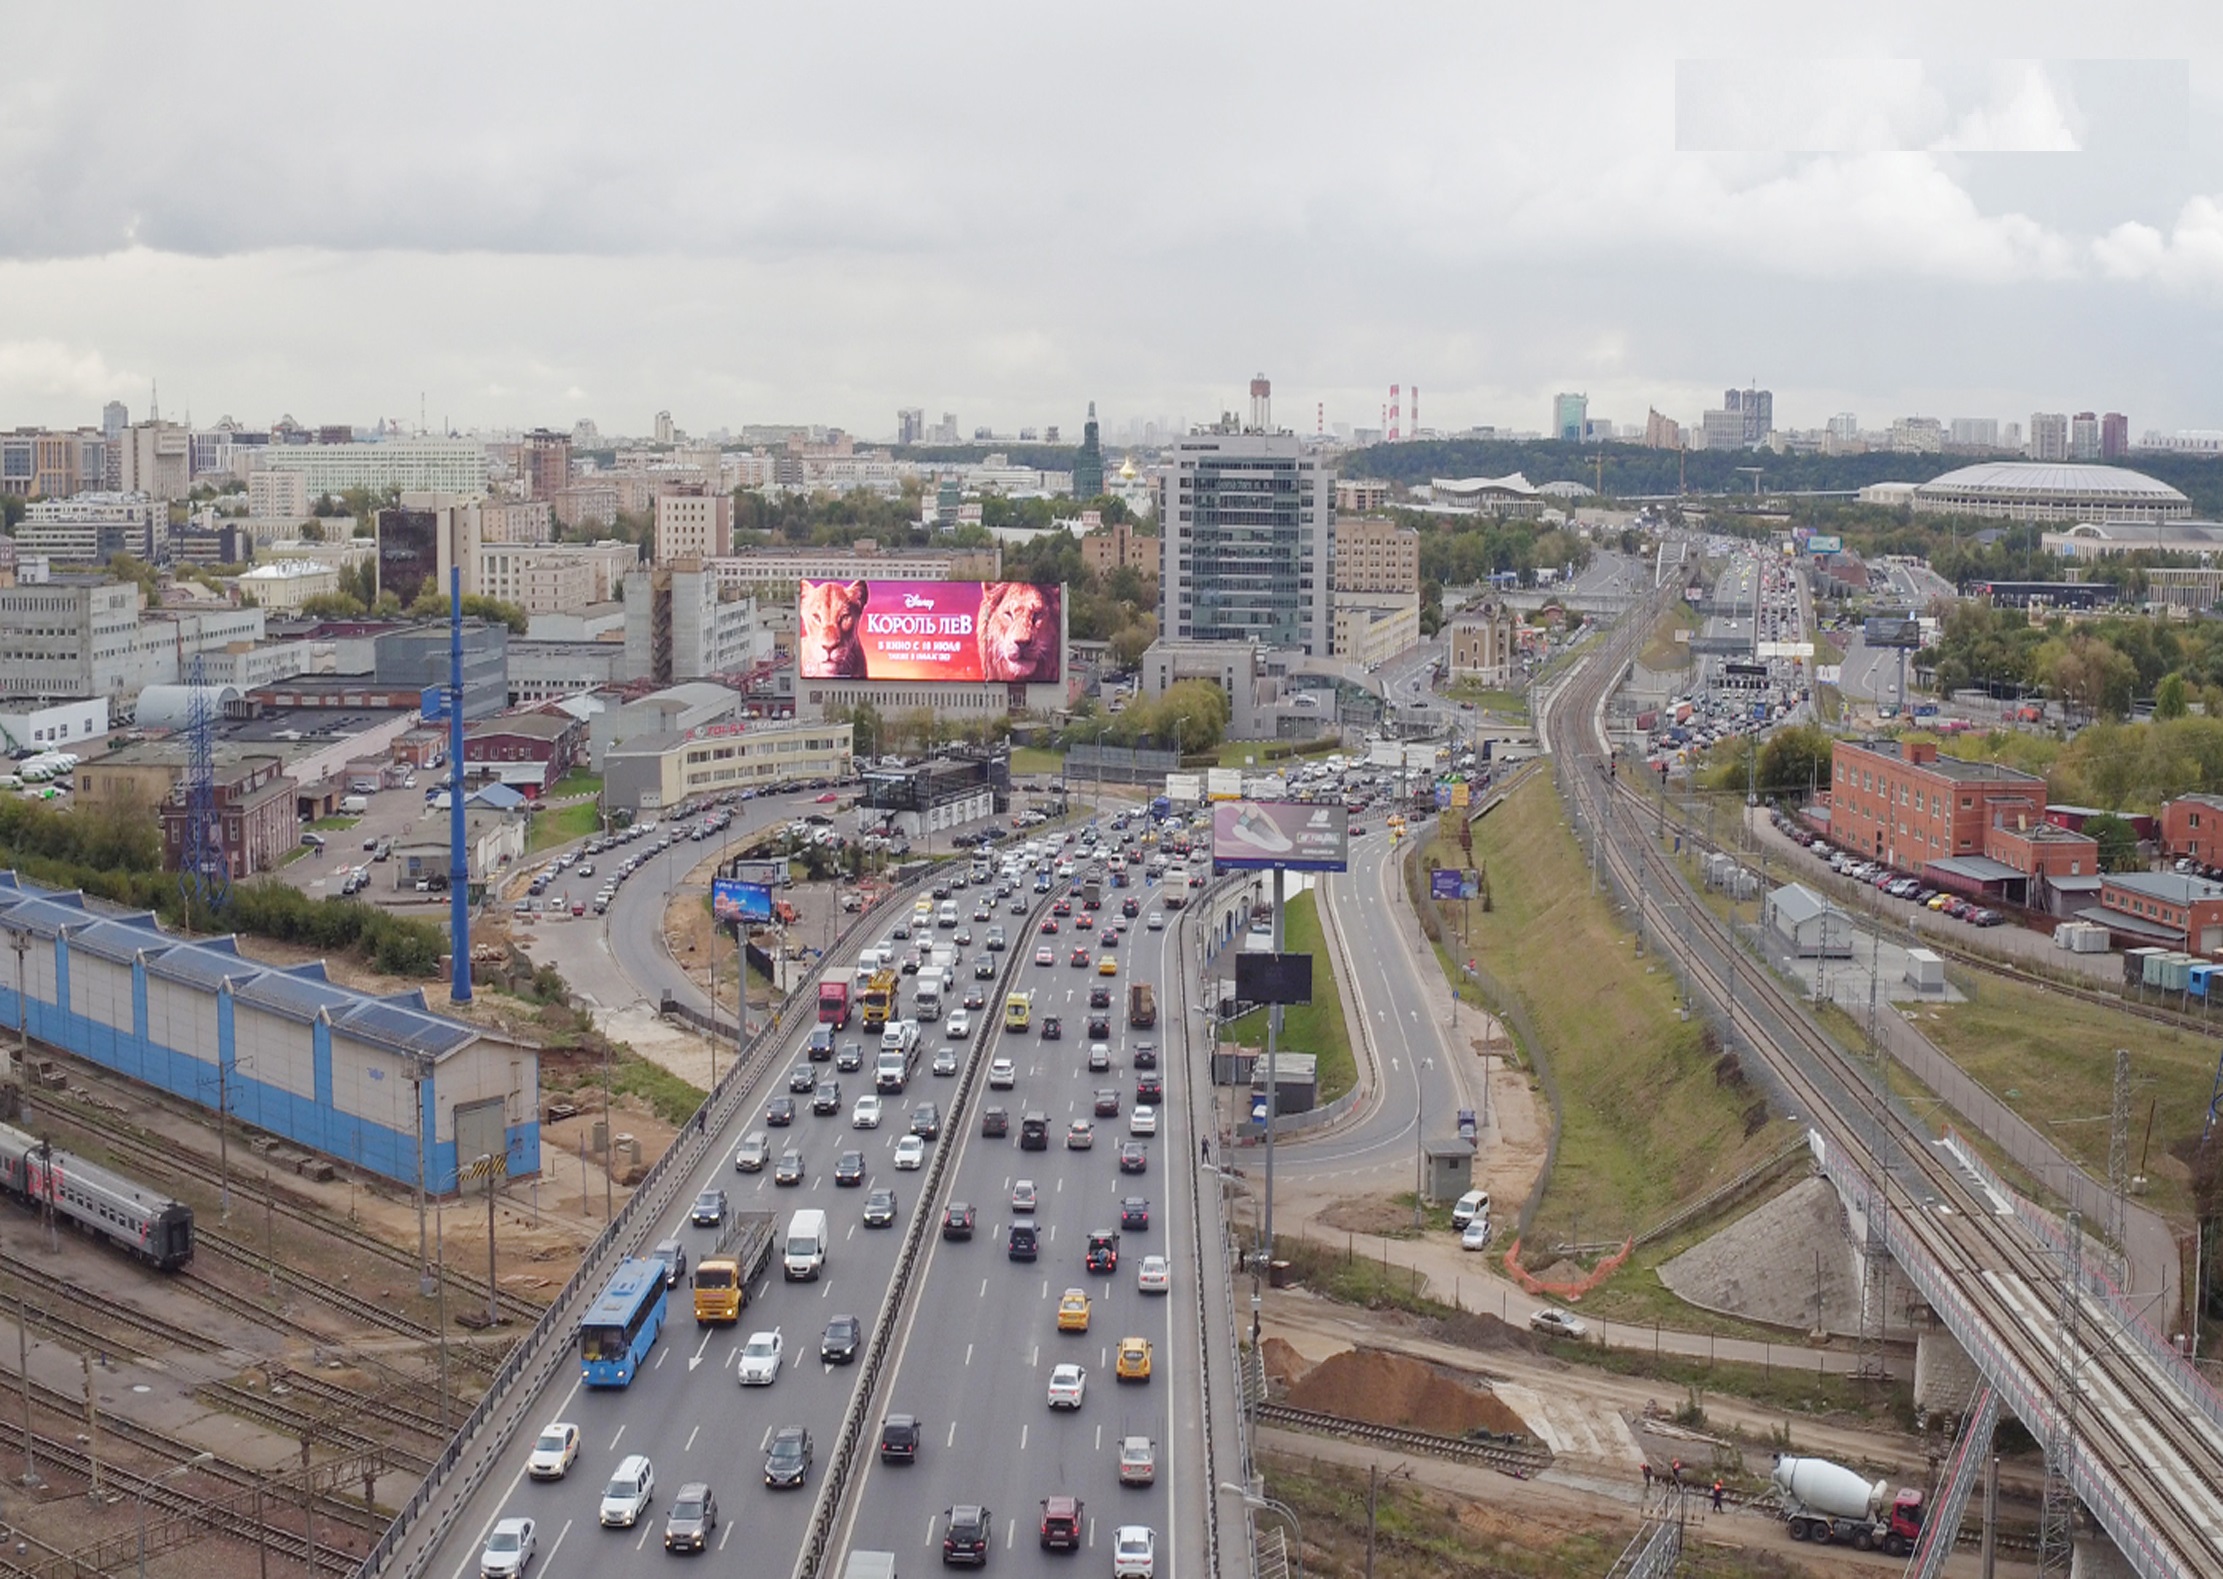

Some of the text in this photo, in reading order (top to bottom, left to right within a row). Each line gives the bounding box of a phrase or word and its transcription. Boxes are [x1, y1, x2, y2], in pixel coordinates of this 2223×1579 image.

[903, 594, 934, 610] Disney
[867, 613, 972, 634] КОРОЛЬ ЛЕВ
[886, 641, 911, 650] КИНО
[913, 641, 919, 650] С
[933, 641, 961, 652] ИЮЛЯ
